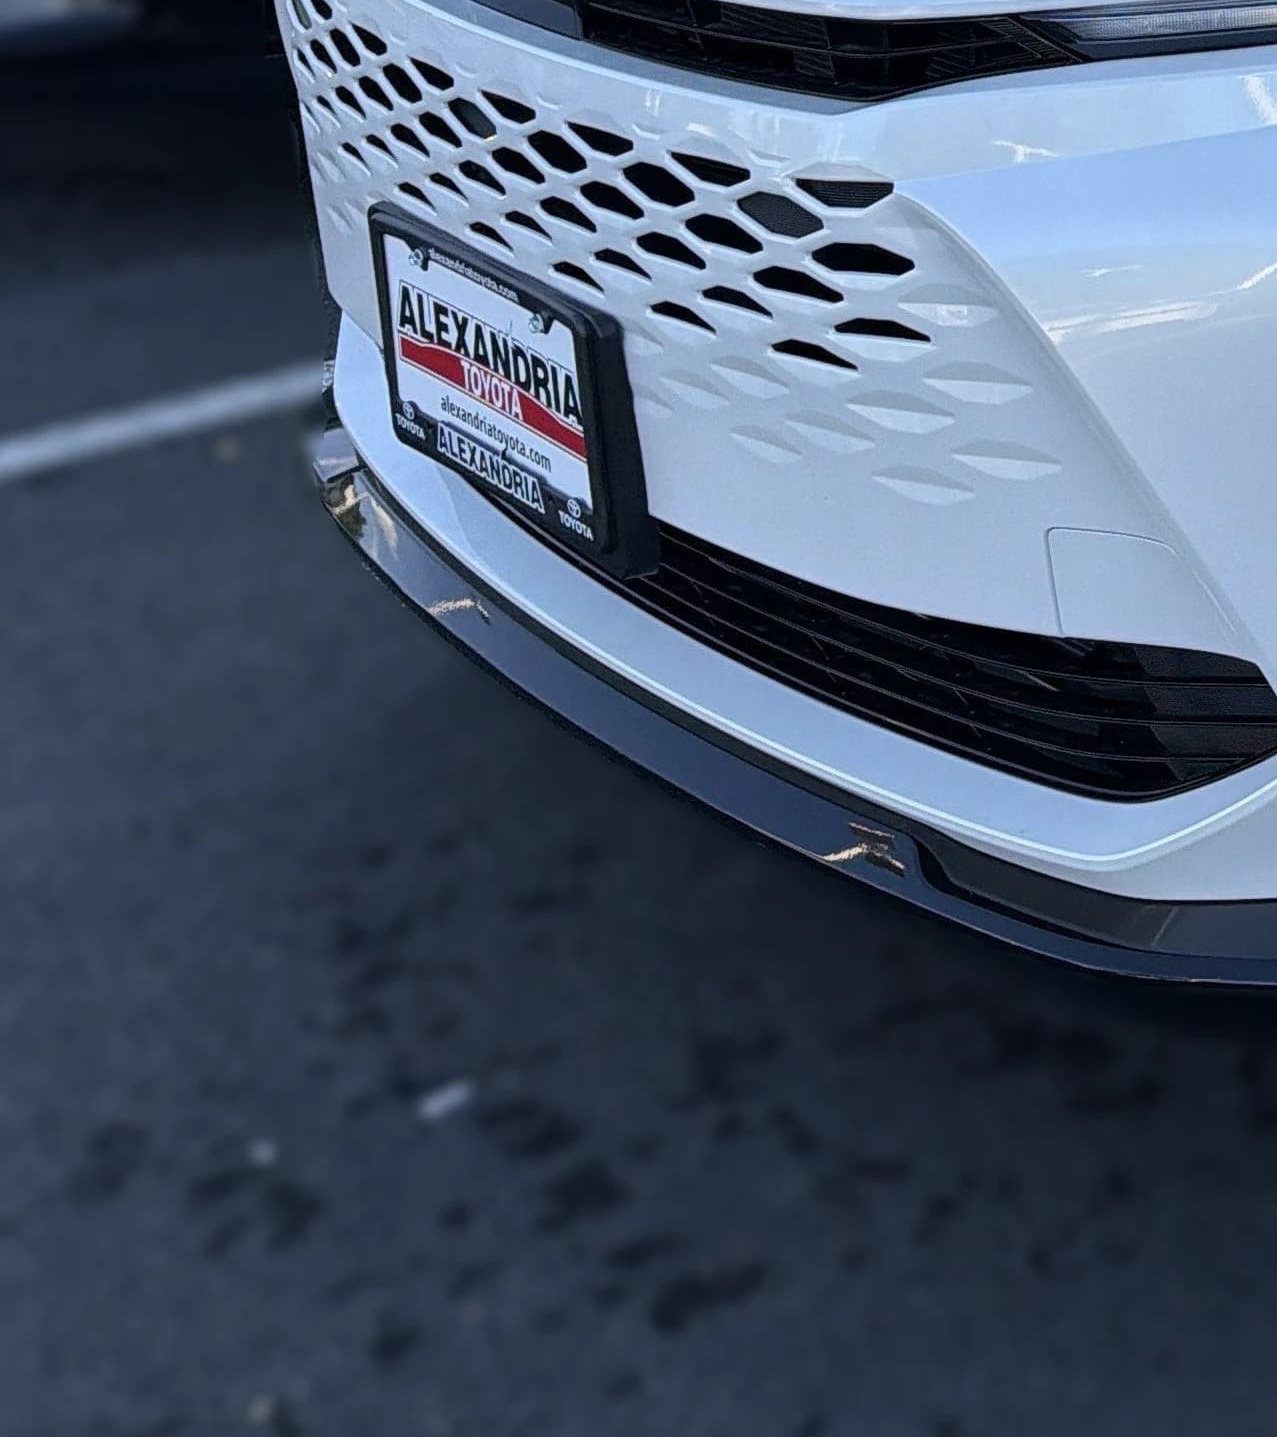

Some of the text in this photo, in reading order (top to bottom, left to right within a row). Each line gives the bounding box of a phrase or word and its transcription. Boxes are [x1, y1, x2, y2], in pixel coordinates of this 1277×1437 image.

[399, 284, 582, 423] ALEXANDRIA
[460, 359, 525, 422] TOYOTA
[395, 412, 426, 441] TOYOTA
[441, 395, 551, 472] alexandriatoyota.com
[437, 422, 546, 514] ALEXANDRIA
[558, 509, 594, 542] TOYOTA
